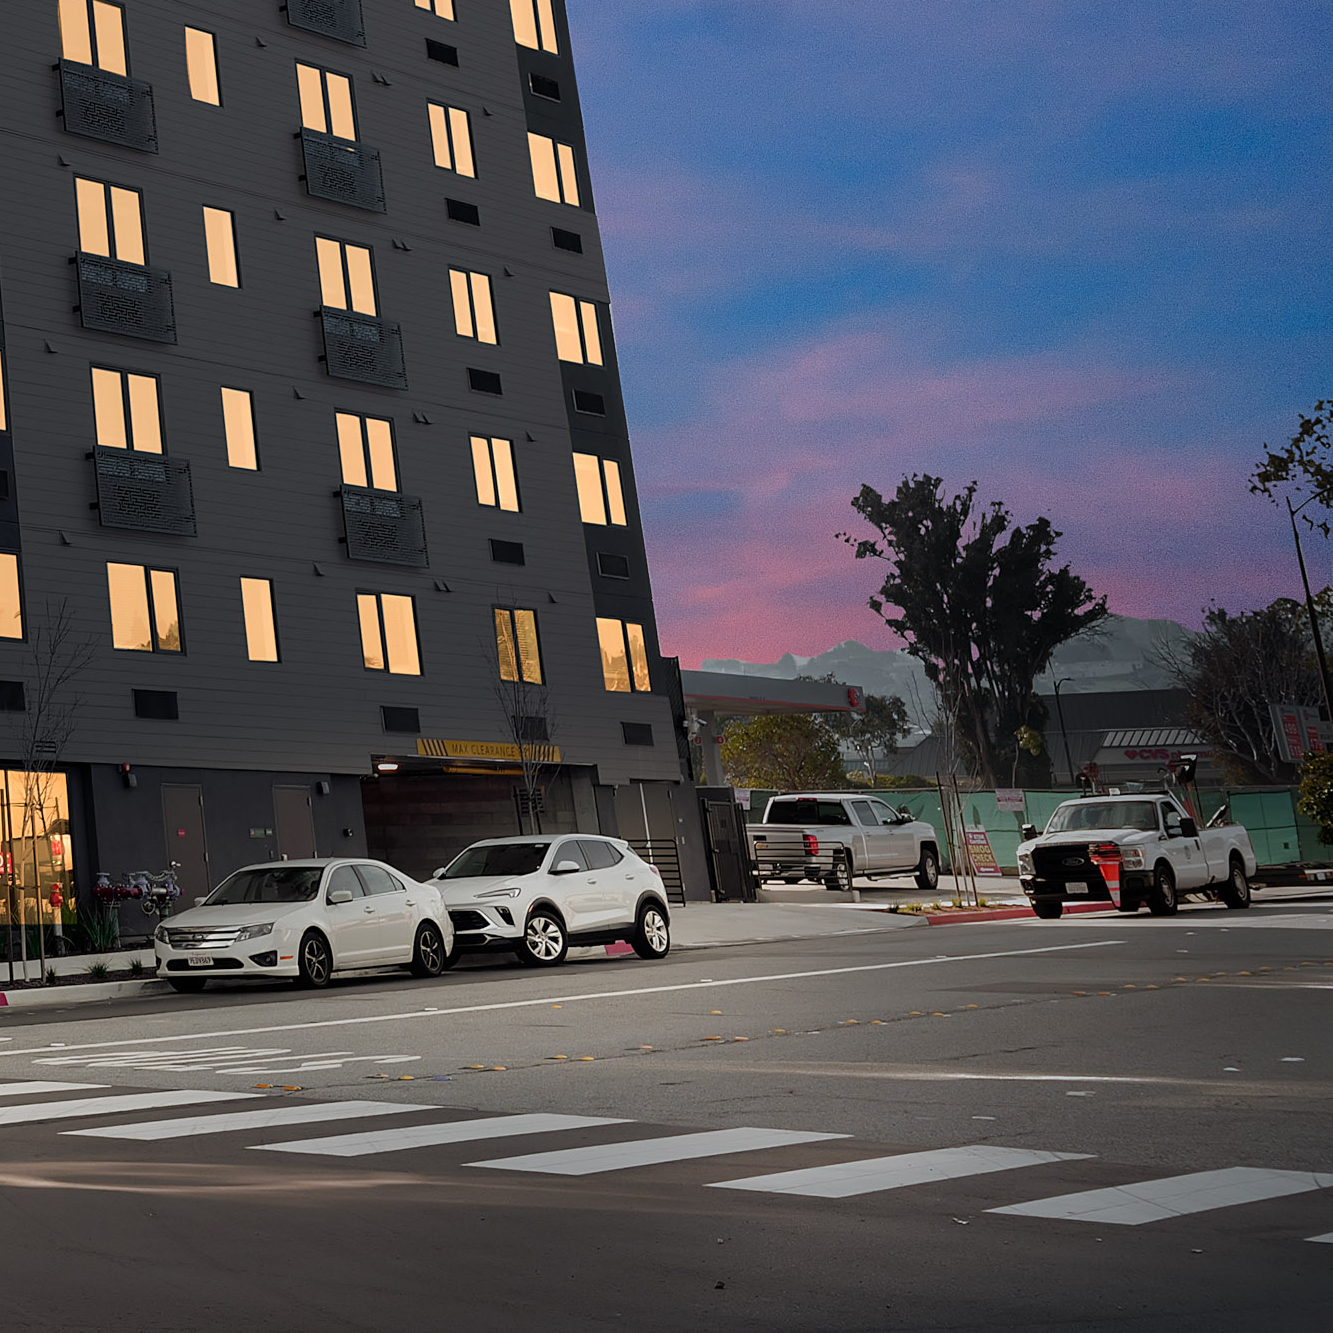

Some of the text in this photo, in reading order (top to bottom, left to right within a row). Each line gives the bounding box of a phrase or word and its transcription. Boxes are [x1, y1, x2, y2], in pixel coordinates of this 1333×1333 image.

[451, 744, 468, 755] MAX
[471, 745, 515, 757] CLEARANCE
[1139, 749, 1169, 760] CVS
[969, 845, 991, 854] SMOG
[972, 854, 993, 862] CHECK
